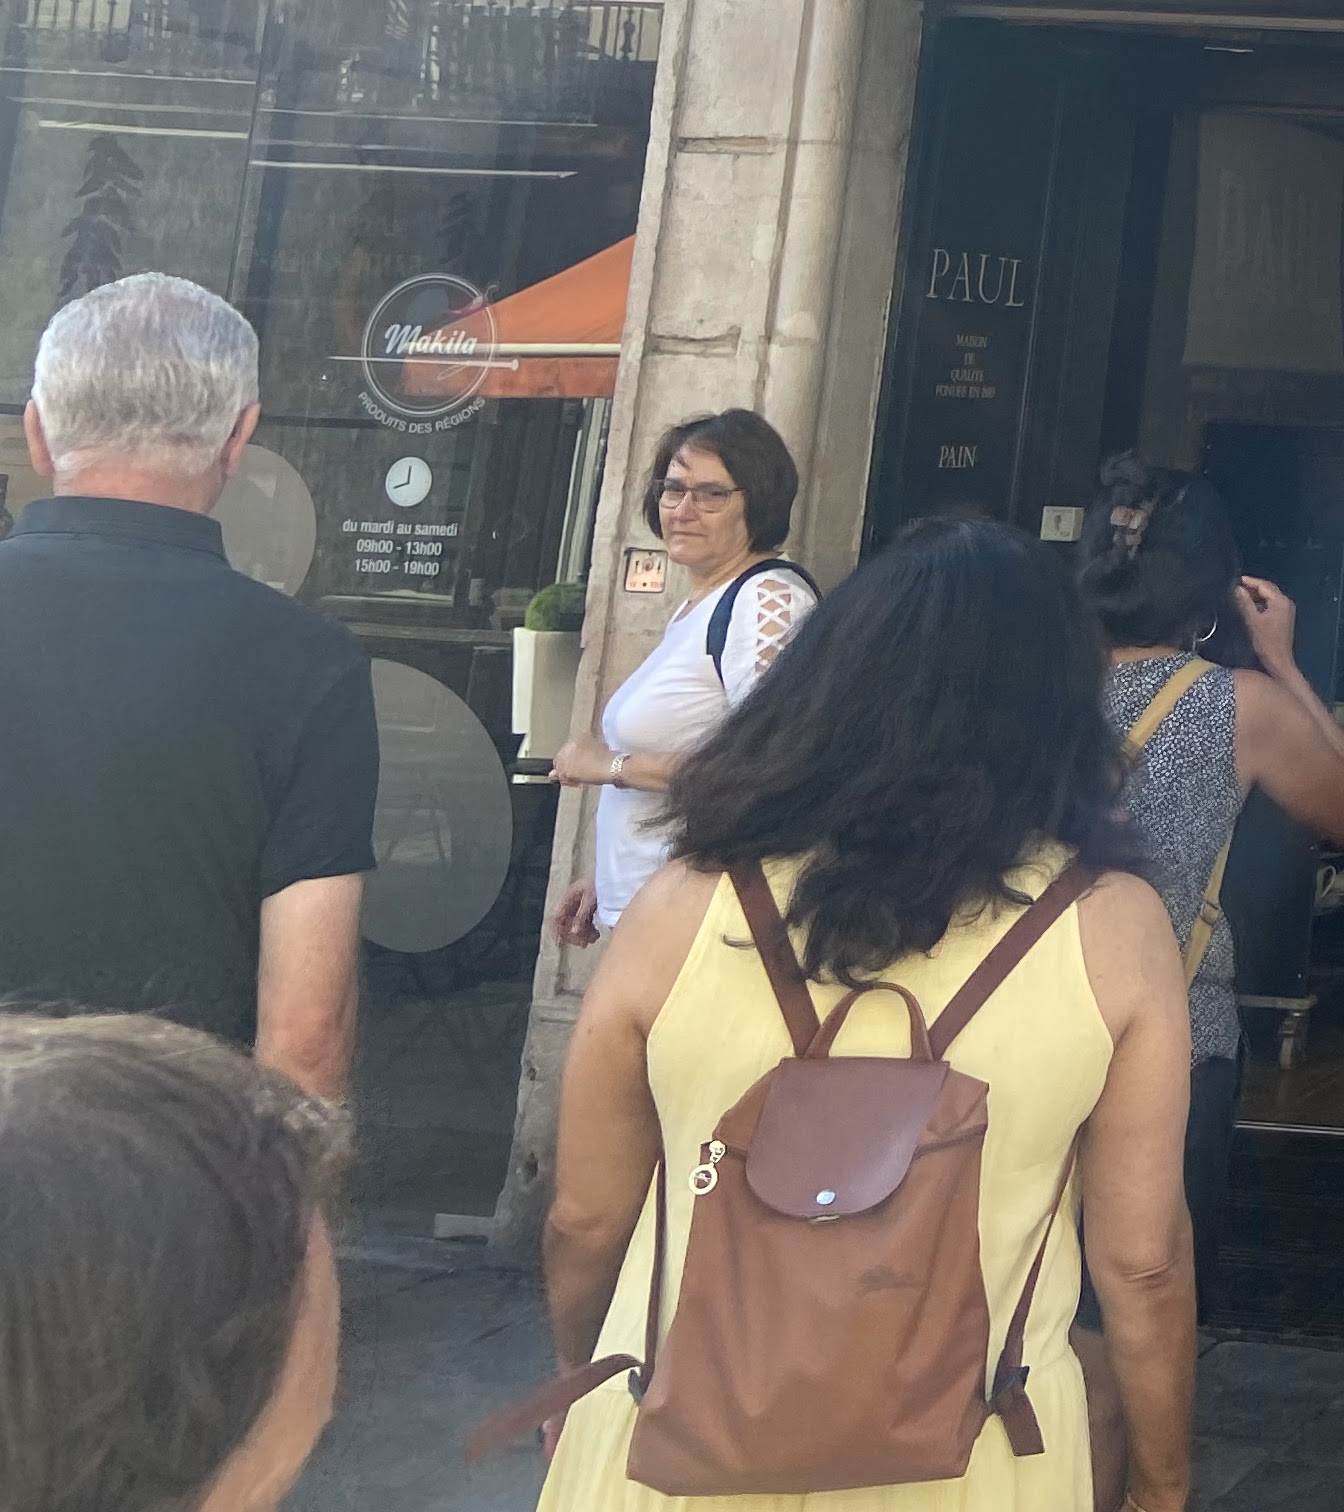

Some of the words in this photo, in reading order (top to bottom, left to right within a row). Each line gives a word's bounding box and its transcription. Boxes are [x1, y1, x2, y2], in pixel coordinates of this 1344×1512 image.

[925, 248, 1025, 308] PAUL
[384, 324, 478, 355] Makila
[357, 391, 407, 432] PRODUITS
[408, 422, 433, 435] DES
[435, 396, 486, 432] RÉGIONS
[938, 445, 978, 469] PAIN
[342, 519, 358, 532] du
[360, 520, 394, 534] mardi
[396, 523, 412, 535] au
[414, 523, 459, 537] samedi
[356, 539, 394, 554] 09h00
[405, 541, 443, 556] 13h00
[355, 558, 391, 573] 15h00
[404, 561, 440, 576] 19h00
